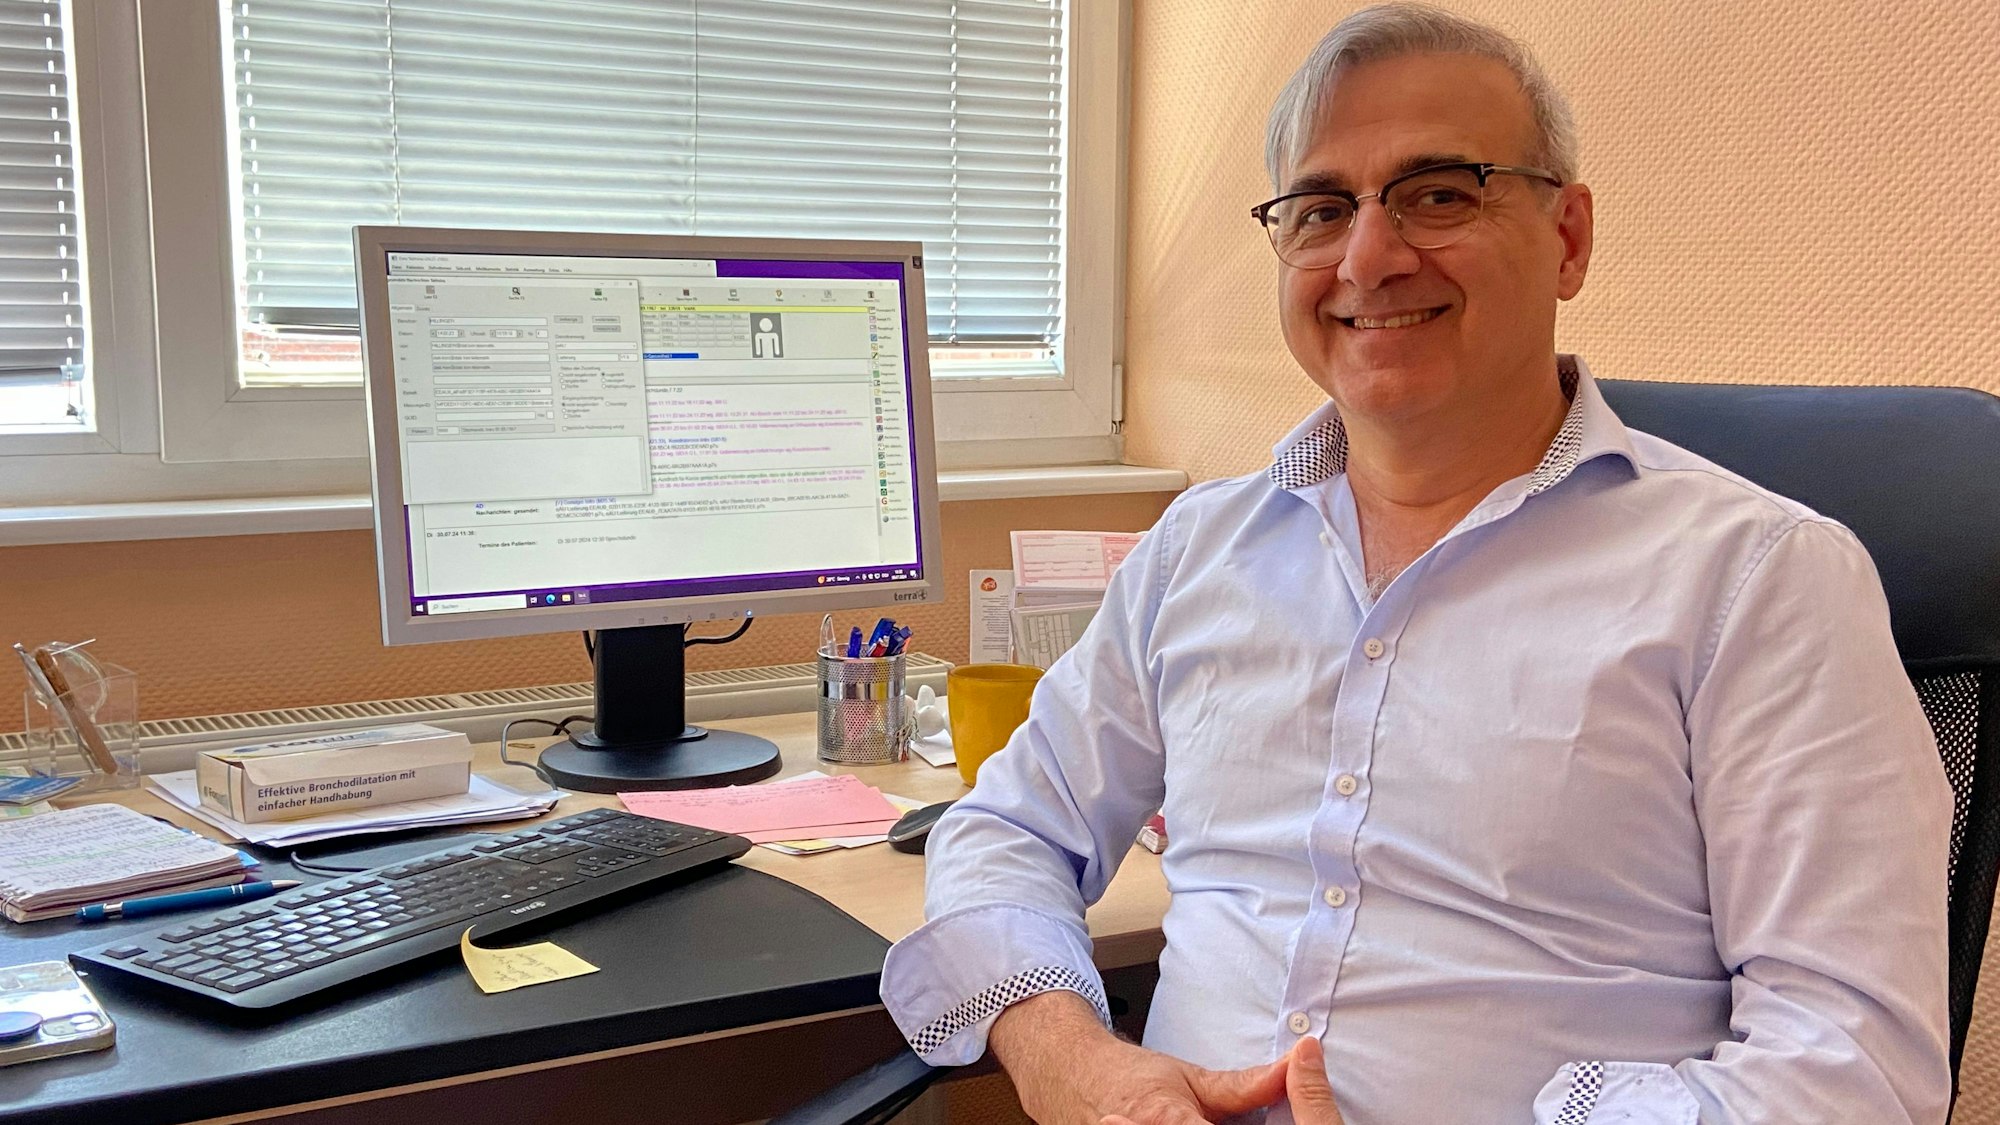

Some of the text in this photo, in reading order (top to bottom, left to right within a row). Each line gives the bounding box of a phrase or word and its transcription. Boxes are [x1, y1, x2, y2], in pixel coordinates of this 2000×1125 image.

[893, 591, 918, 601] terra
[257, 770, 416, 799] Effektive Bronchodilatation mit
[257, 788, 373, 812] einfacher Handhabung
